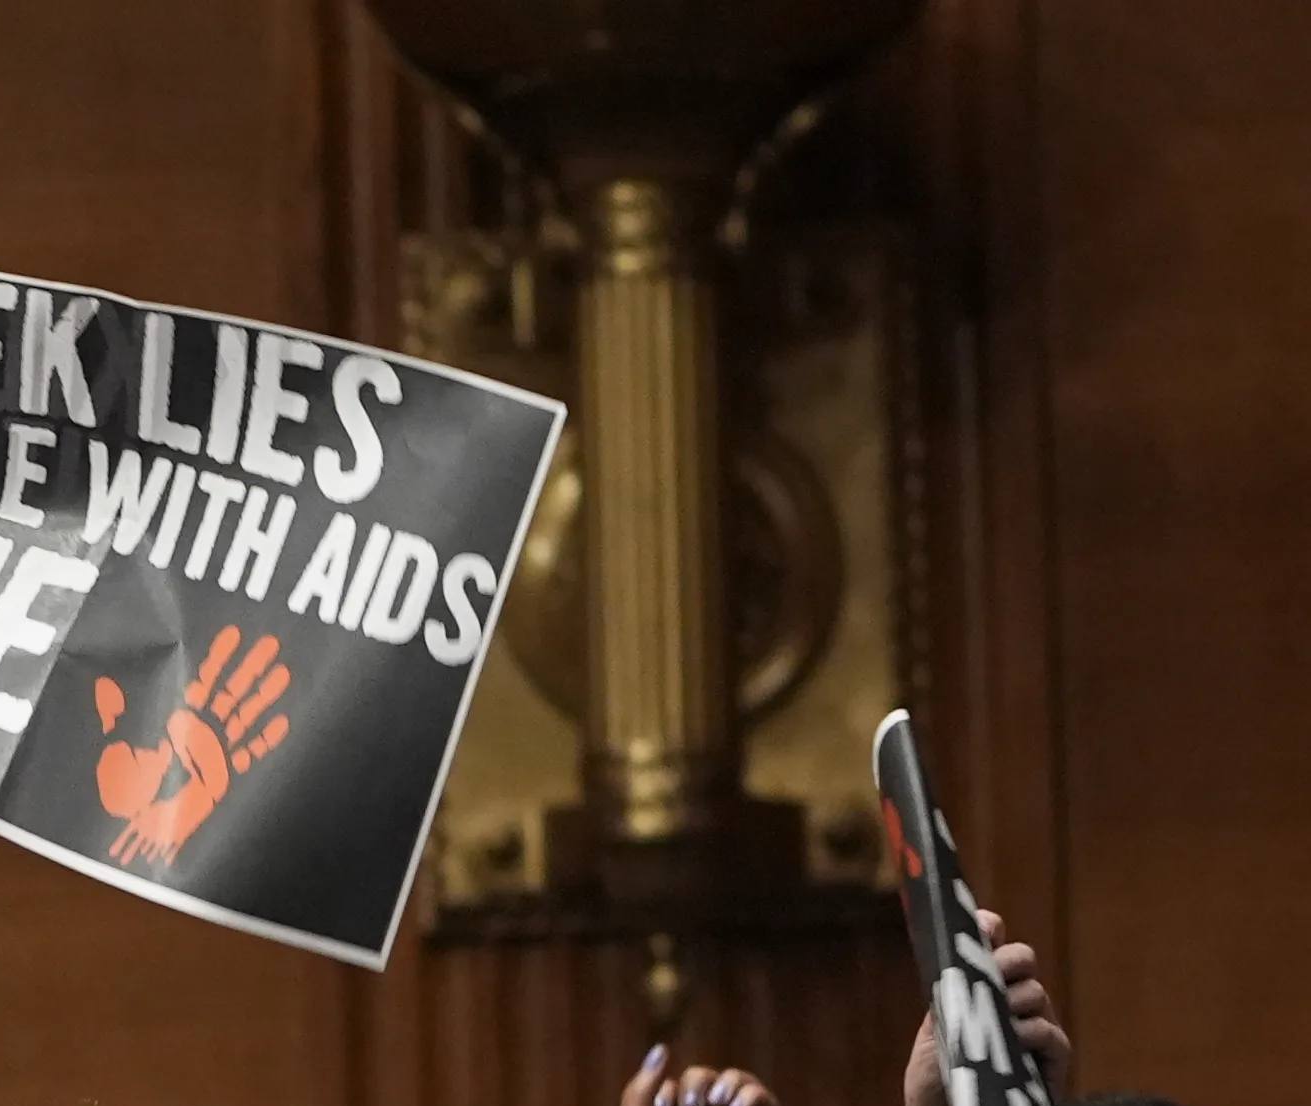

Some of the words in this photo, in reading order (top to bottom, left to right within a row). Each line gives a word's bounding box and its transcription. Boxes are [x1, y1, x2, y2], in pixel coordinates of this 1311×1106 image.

[136, 310, 403, 505] LIES
[81, 438, 298, 602] WITH
[287, 512, 499, 667] AIDS
